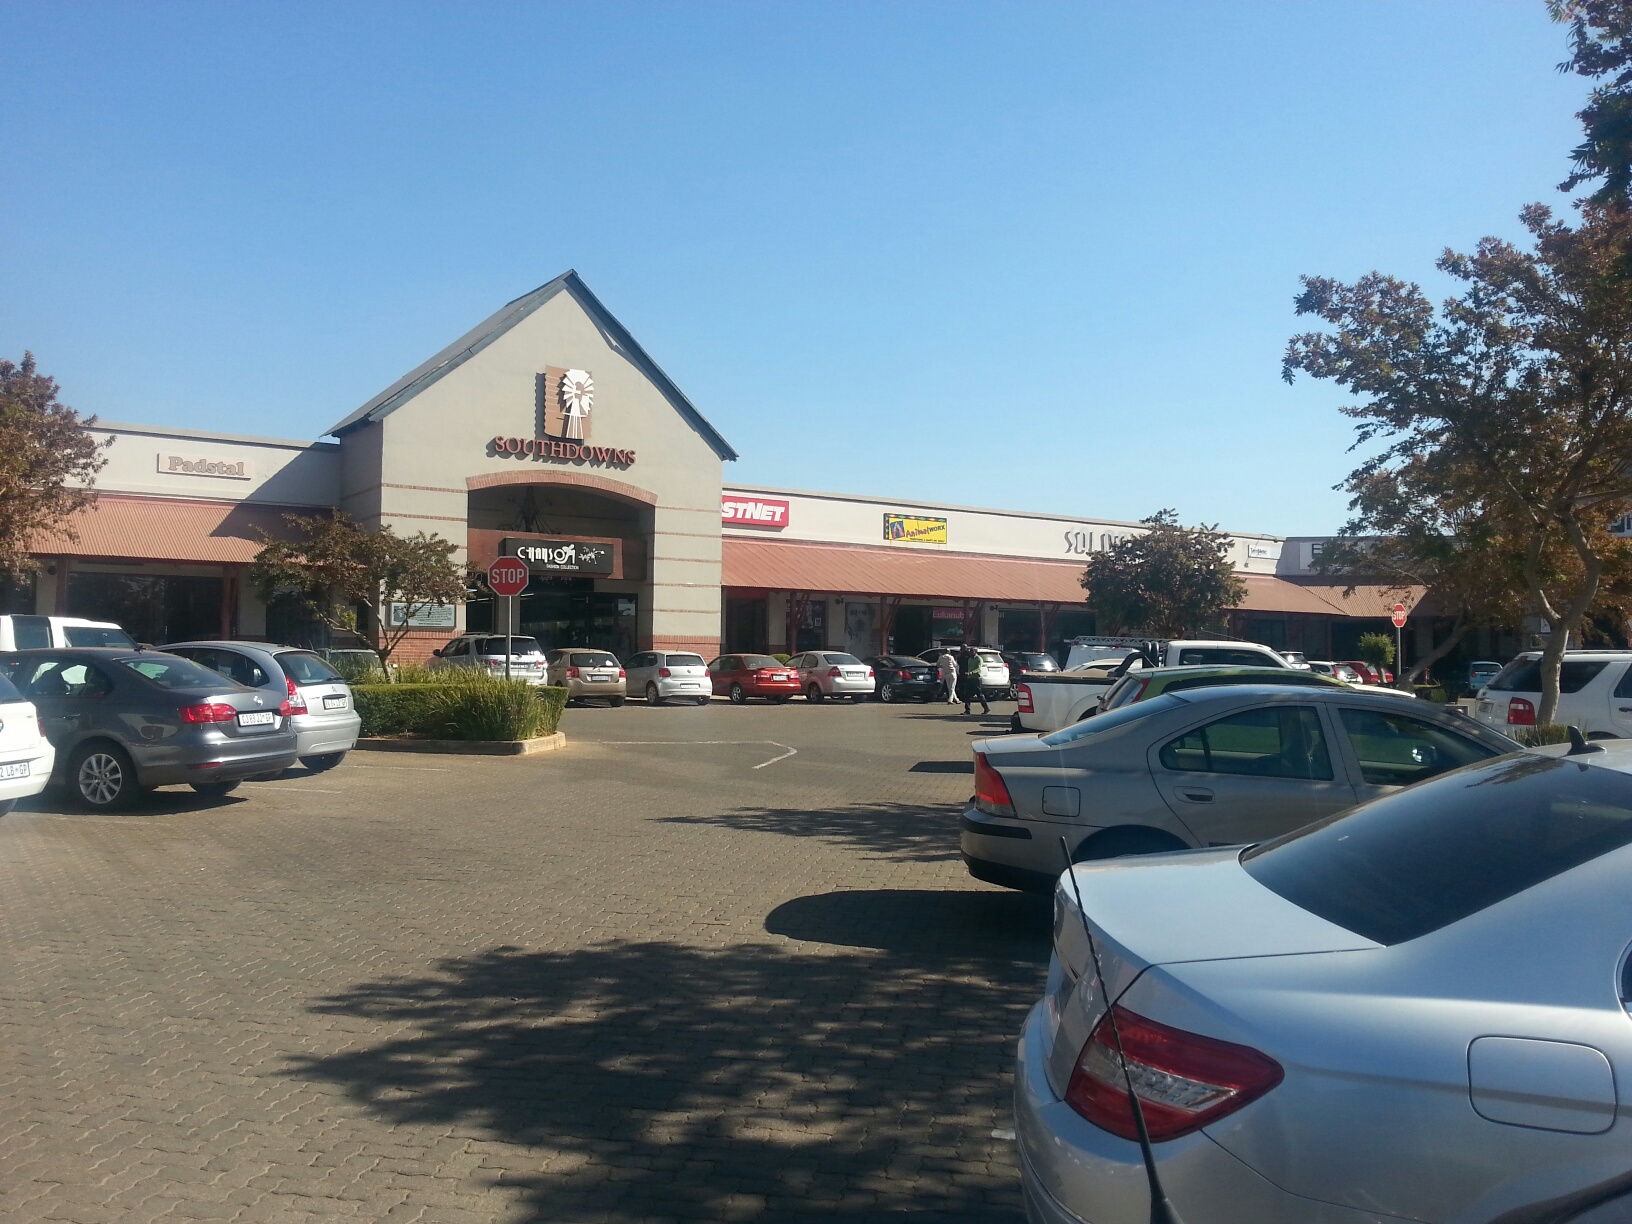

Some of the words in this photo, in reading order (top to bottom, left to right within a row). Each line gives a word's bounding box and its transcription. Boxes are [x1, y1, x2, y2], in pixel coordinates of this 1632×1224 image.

[494, 435, 637, 465] SOUTHDOWNS
[168, 455, 245, 476] Padstal
[721, 501, 785, 521] STNET
[491, 568, 525, 584] STOP
[932, 610, 965, 619] Eukanub
[1393, 610, 1405, 620] STOP
